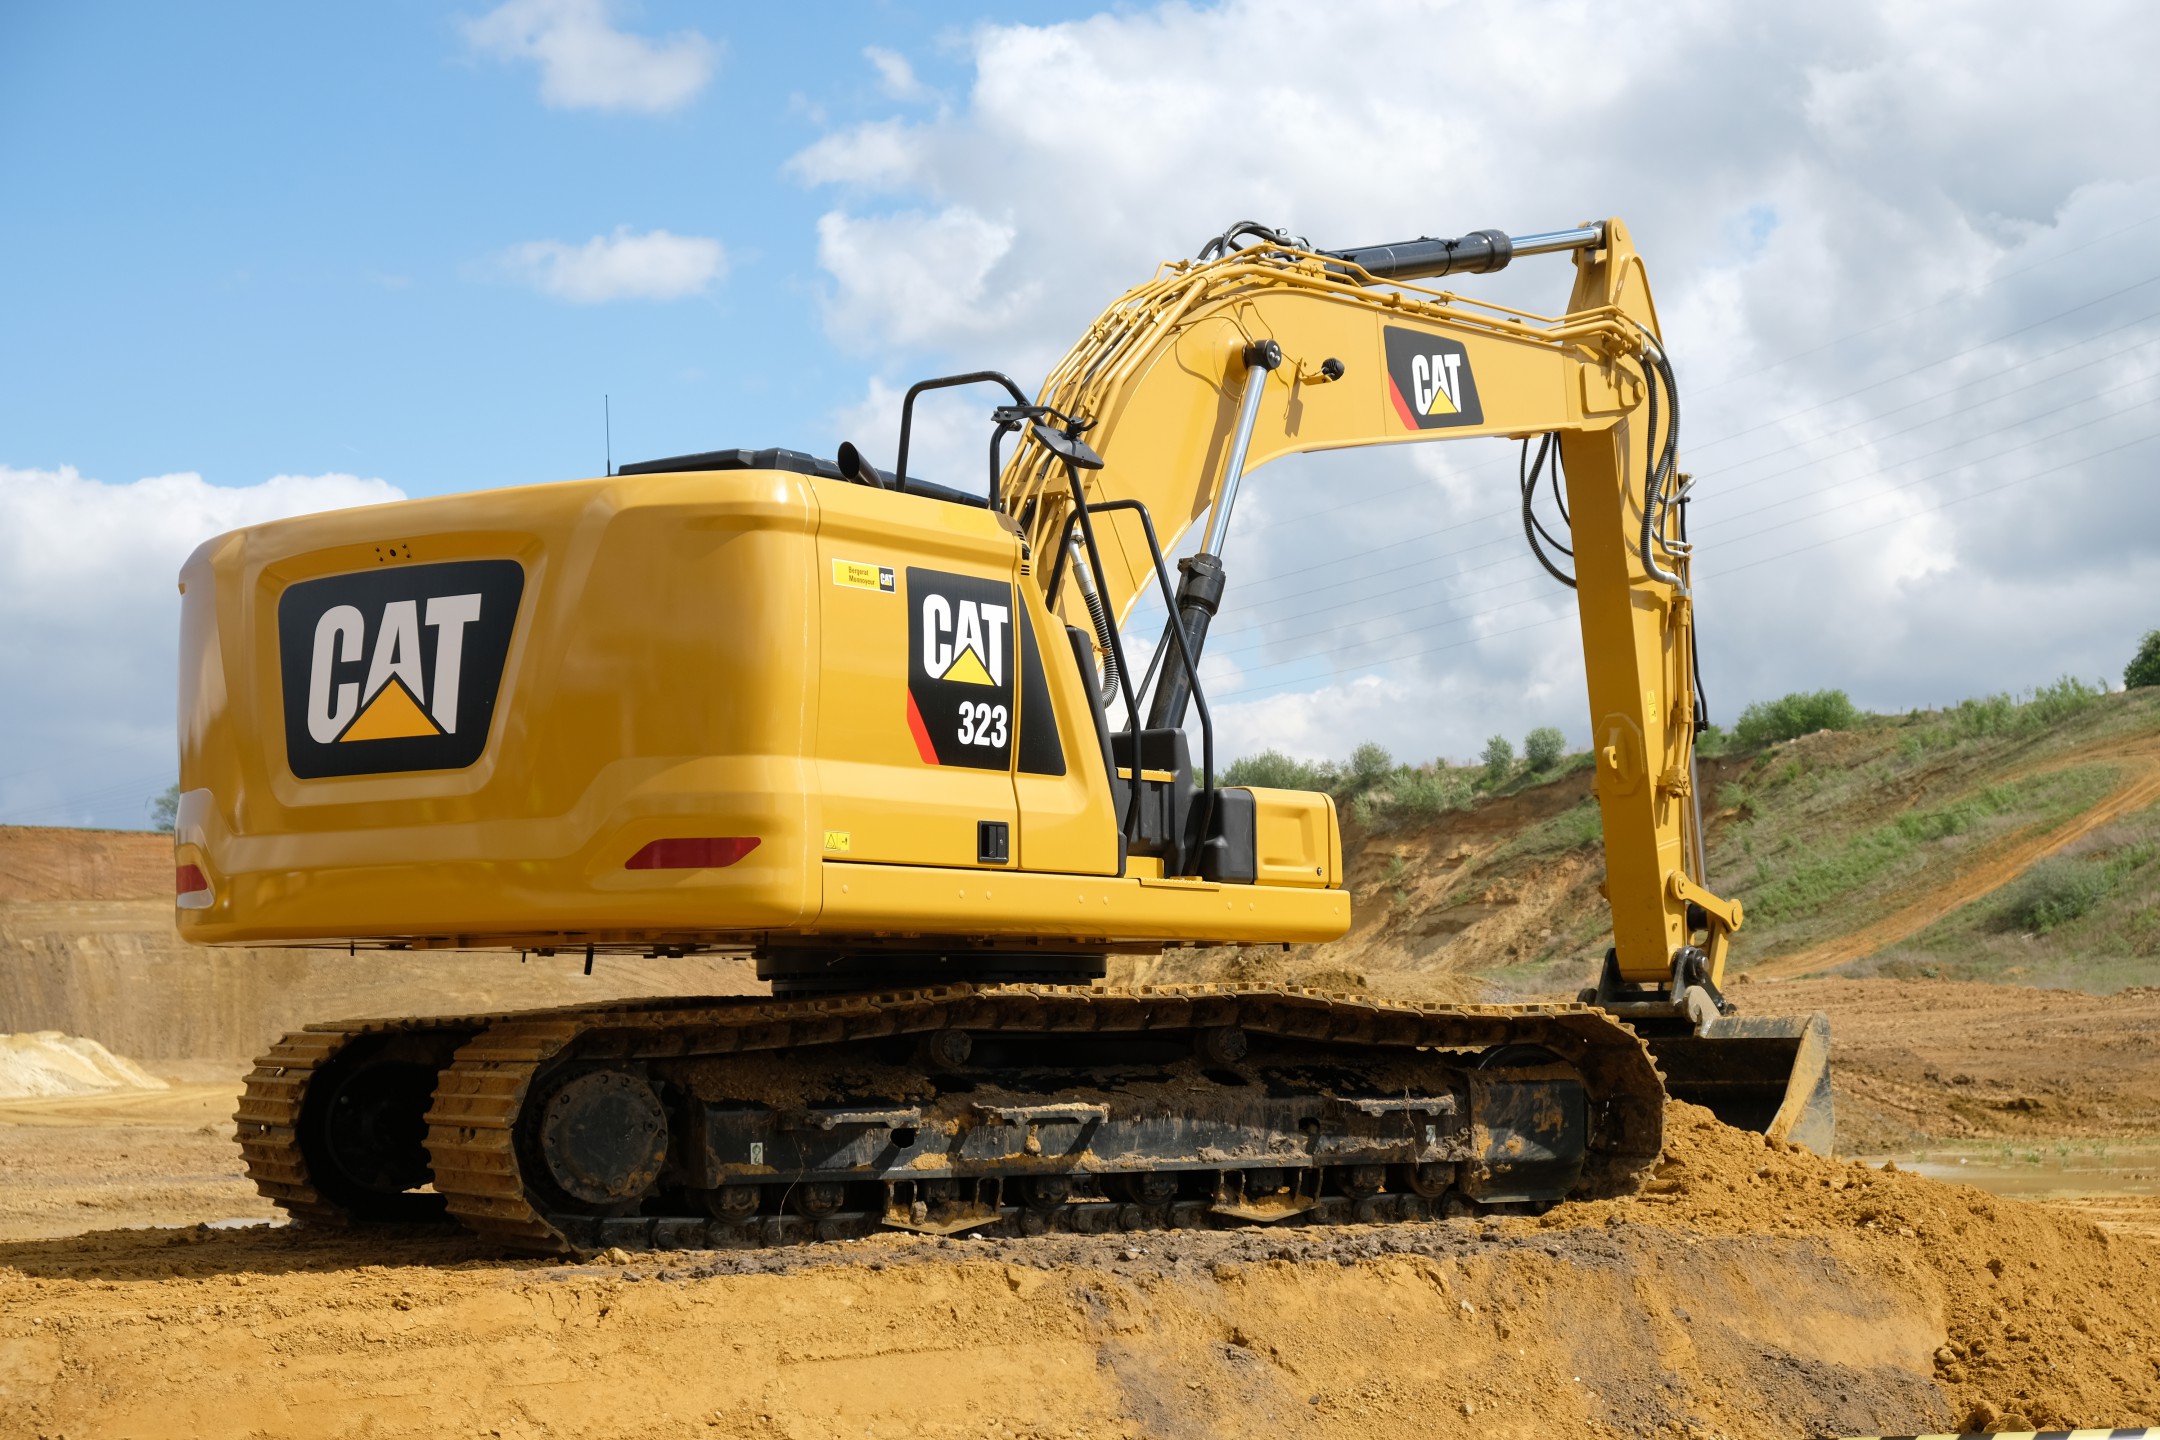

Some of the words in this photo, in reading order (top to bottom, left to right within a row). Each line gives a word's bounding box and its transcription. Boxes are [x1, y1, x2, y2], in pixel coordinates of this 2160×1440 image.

[1412, 353, 1462, 415] CAT
[880, 573, 894, 587] CAT
[307, 593, 482, 744] CAT
[922, 593, 1009, 687] CAT
[957, 700, 1008, 748] 323
